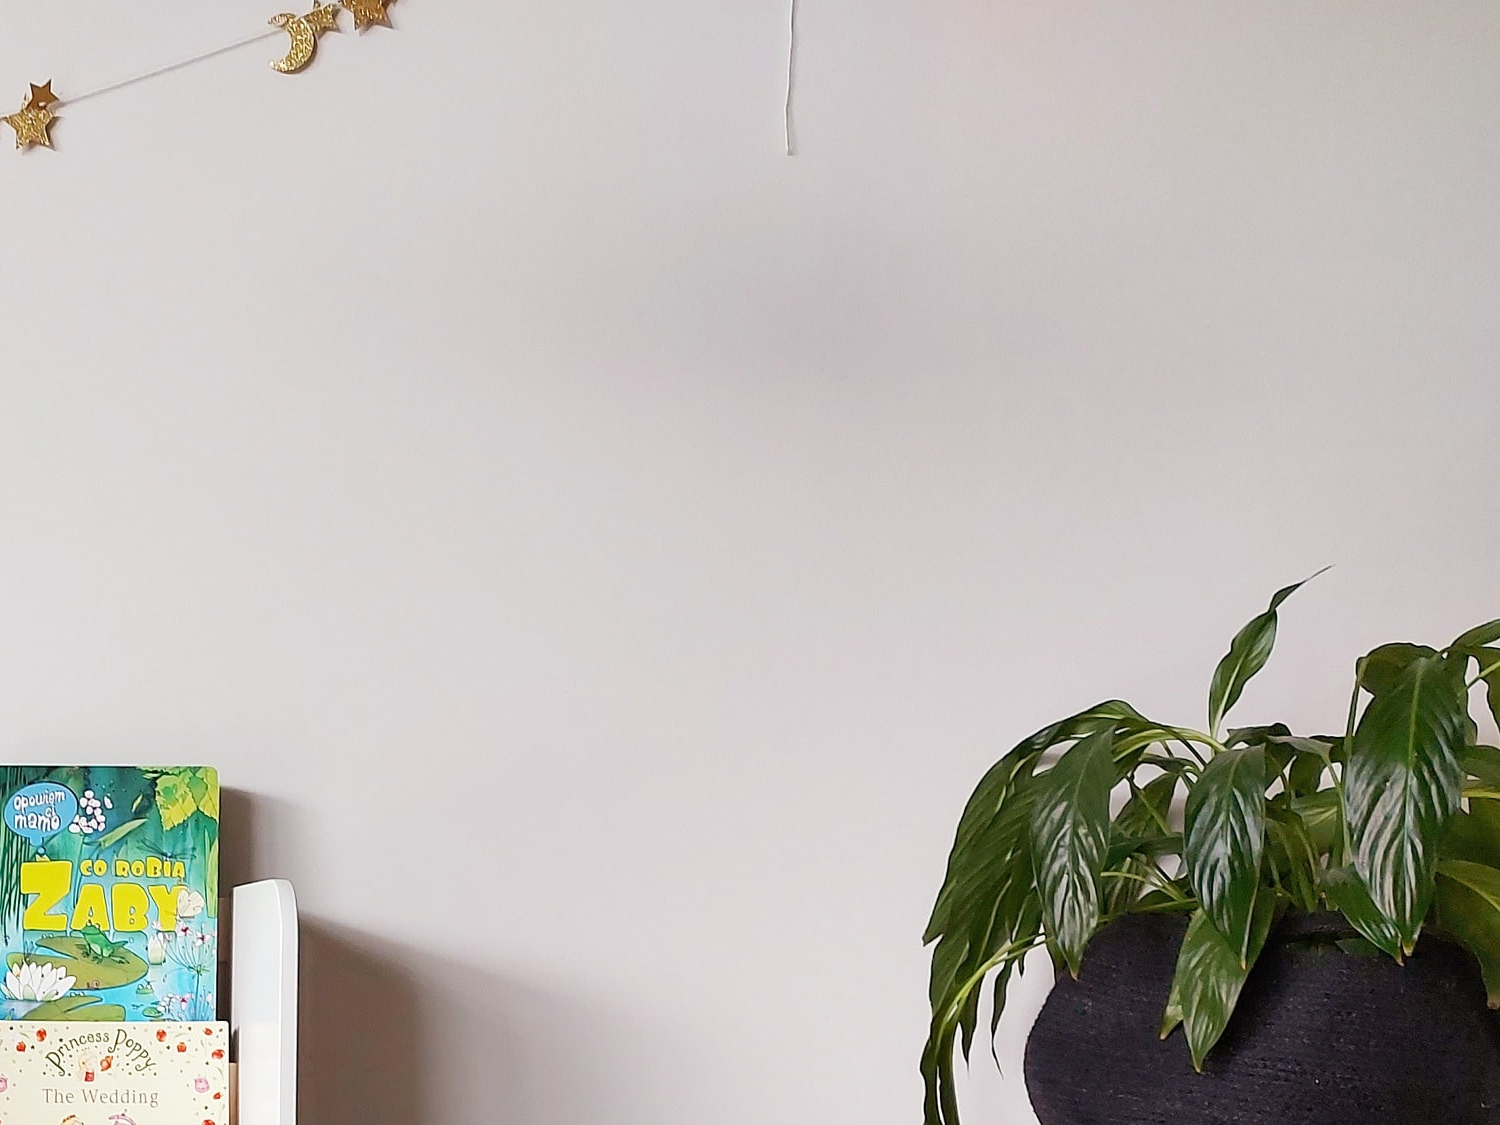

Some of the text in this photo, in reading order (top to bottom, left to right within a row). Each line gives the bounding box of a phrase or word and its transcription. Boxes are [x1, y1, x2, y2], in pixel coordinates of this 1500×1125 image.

[14, 812, 60, 832] mamo
[80, 859, 108, 876] CO
[44, 1028, 159, 1077] Princess Poppy
[42, 1088, 160, 1108] The Wedding
